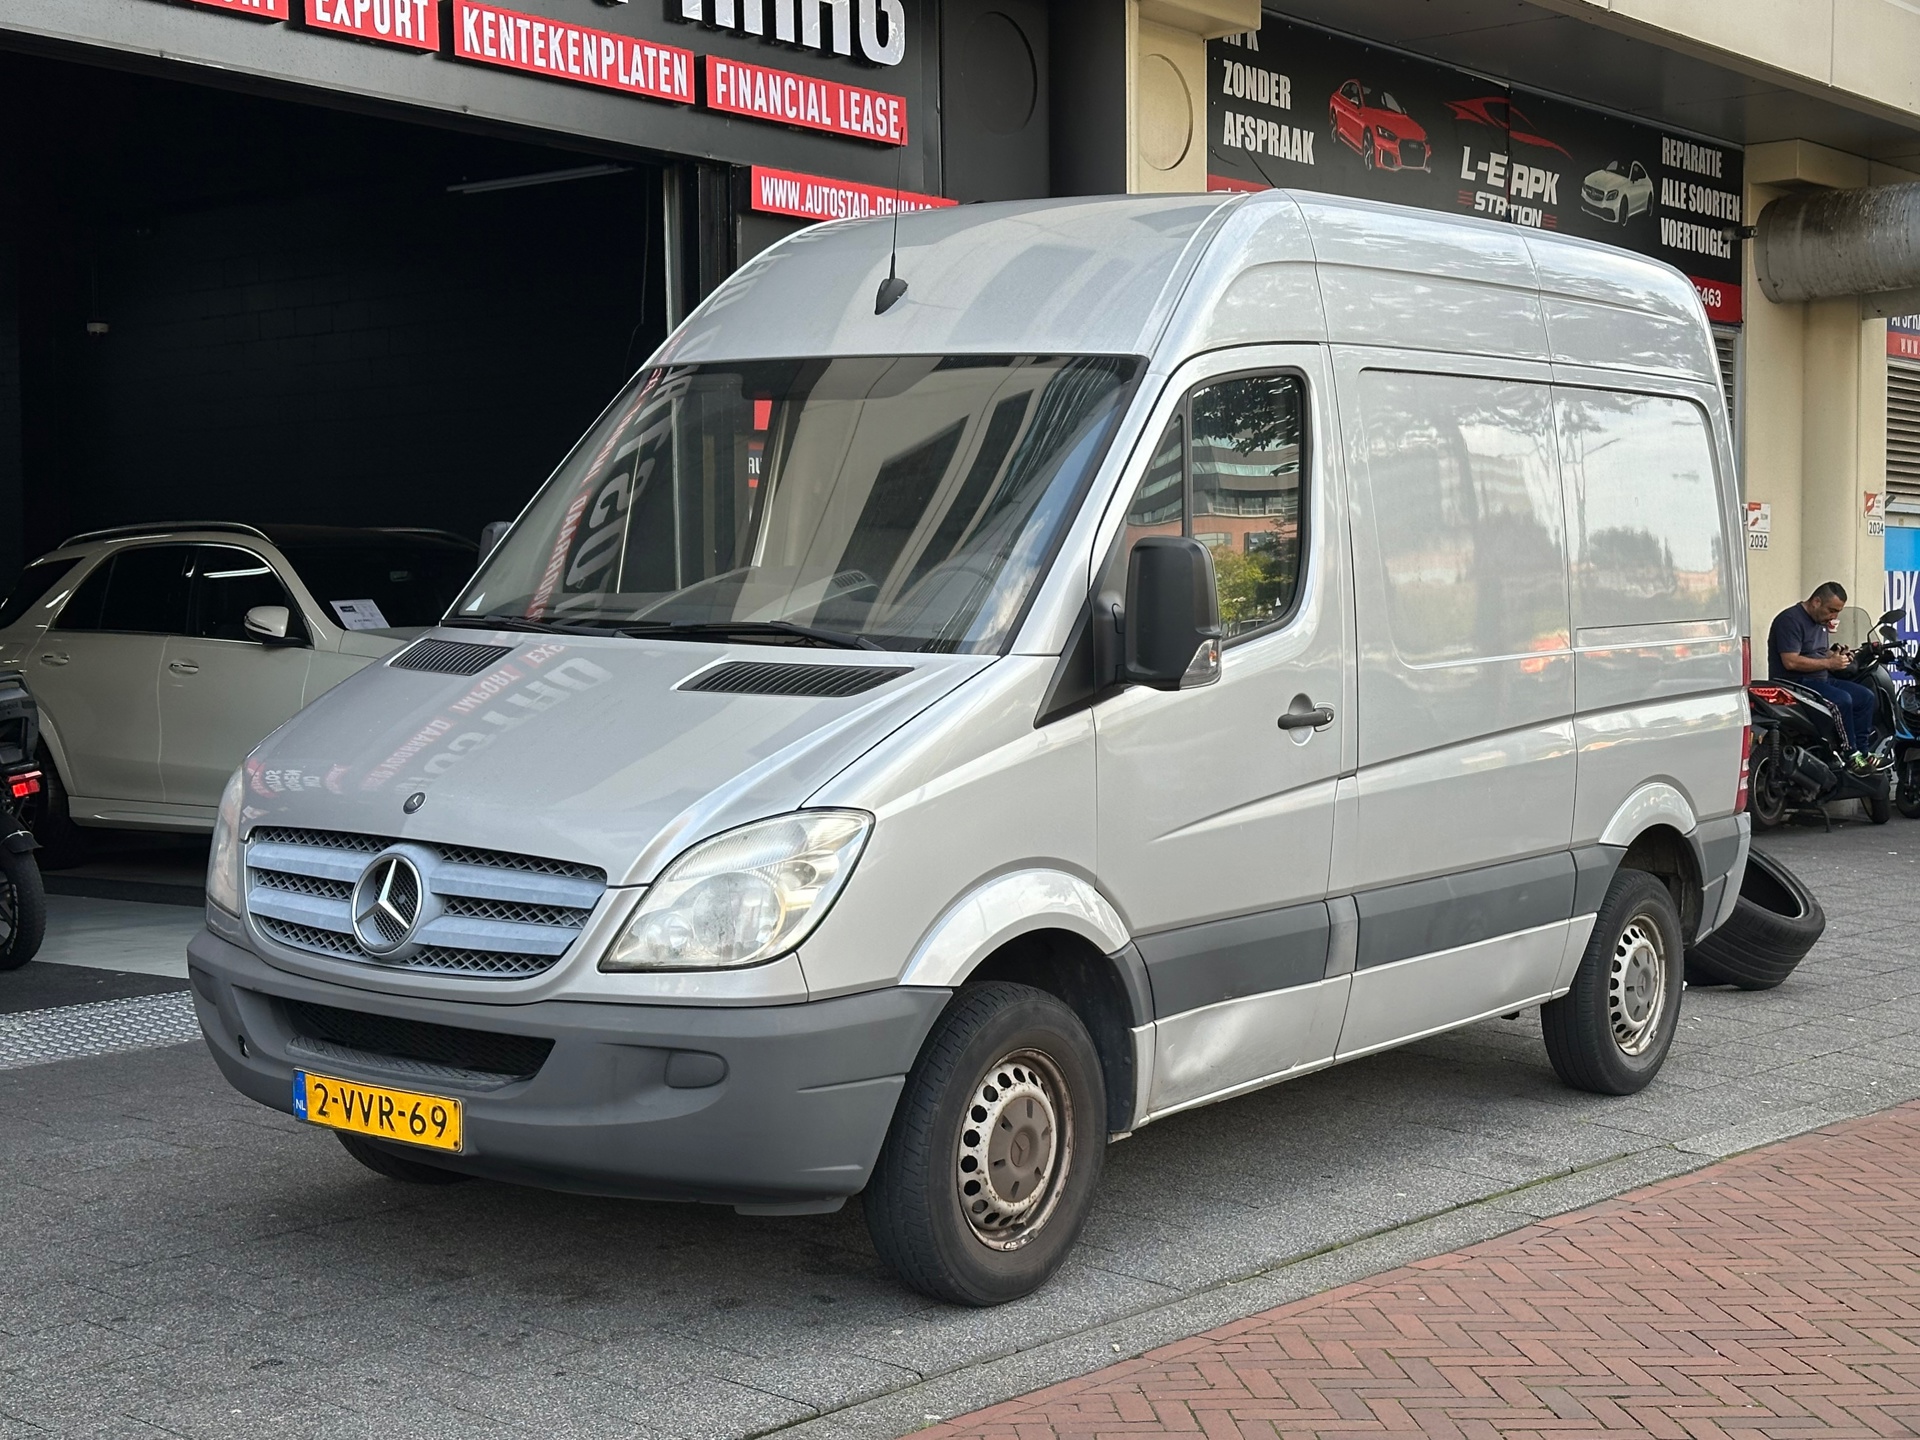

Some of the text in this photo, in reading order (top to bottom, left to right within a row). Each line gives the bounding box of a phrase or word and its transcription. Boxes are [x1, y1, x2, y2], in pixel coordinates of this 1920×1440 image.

[315, 0, 428, 42] EXPORT
[462, 5, 688, 97] KENTEKENPLATEN
[716, 64, 900, 140] FINANCIAL LEASE
[1223, 59, 1291, 110] ZONDER
[1223, 110, 1315, 165] AFSPRAAK
[1661, 136, 1722, 179] REPARATIE
[1510, 162, 1560, 206] APK
[1661, 177, 1740, 223] ALLE SOORTEN
[1474, 190, 1543, 228] STATION
[1750, 534, 1768, 549] 2032
[1869, 521, 1884, 535] 2034
[295, 1098, 306, 1111] NL
[313, 1083, 448, 1139] 2-VVR-69
